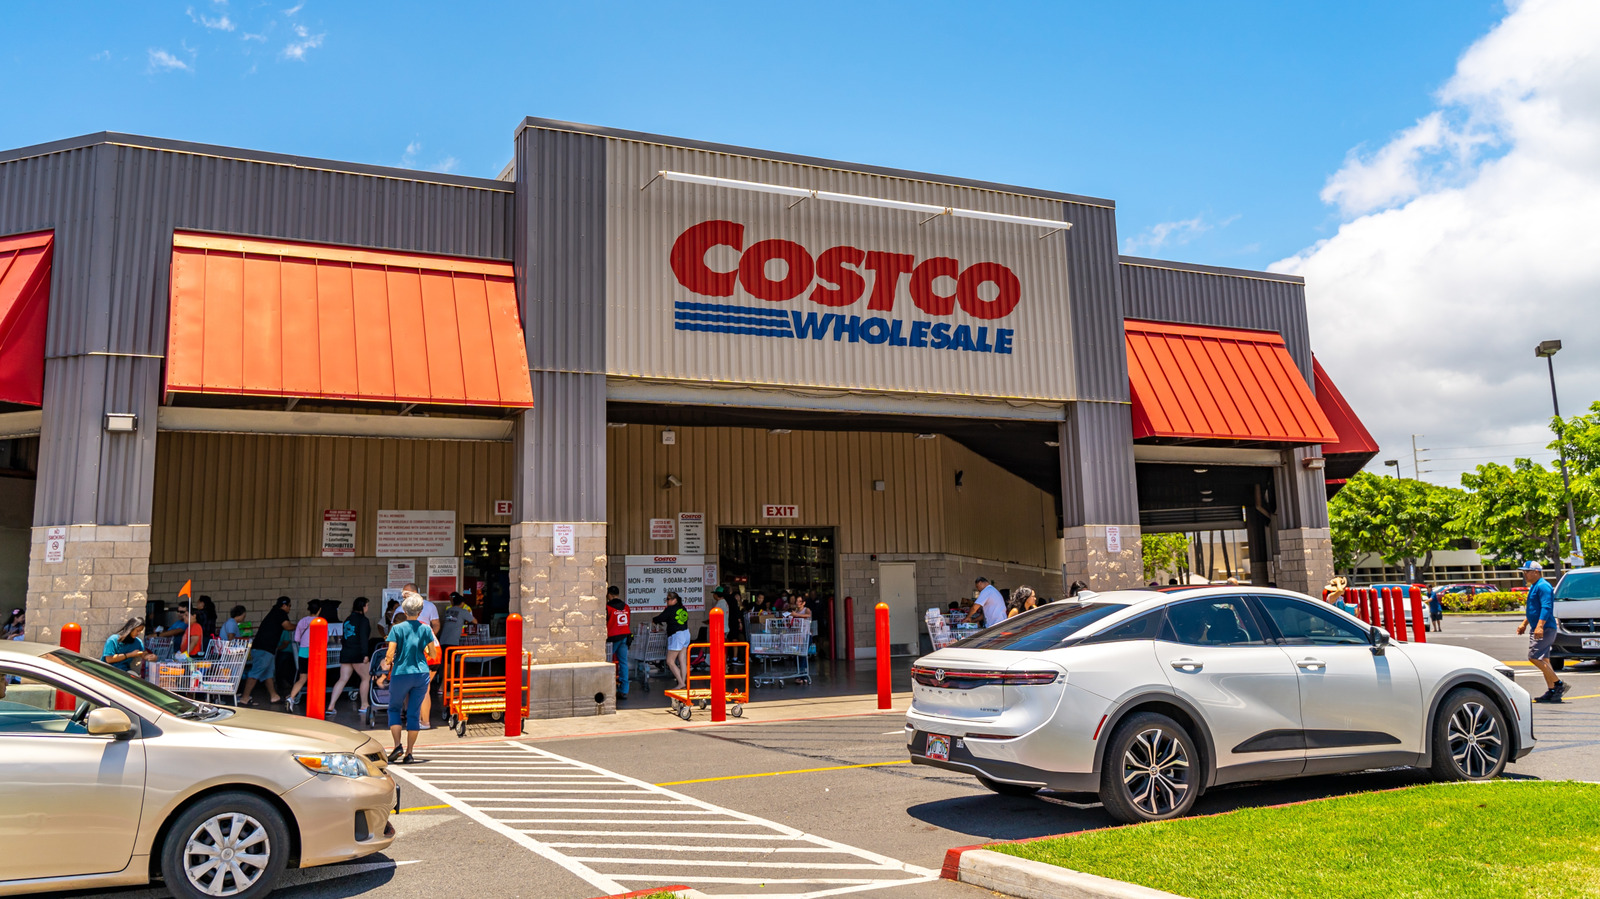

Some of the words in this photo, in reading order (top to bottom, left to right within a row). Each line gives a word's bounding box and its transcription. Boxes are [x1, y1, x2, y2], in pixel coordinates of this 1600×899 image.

[670, 220, 1021, 320] COSTCO
[791, 310, 1014, 354] WHOLESALE
[766, 506, 795, 516] EXIT
